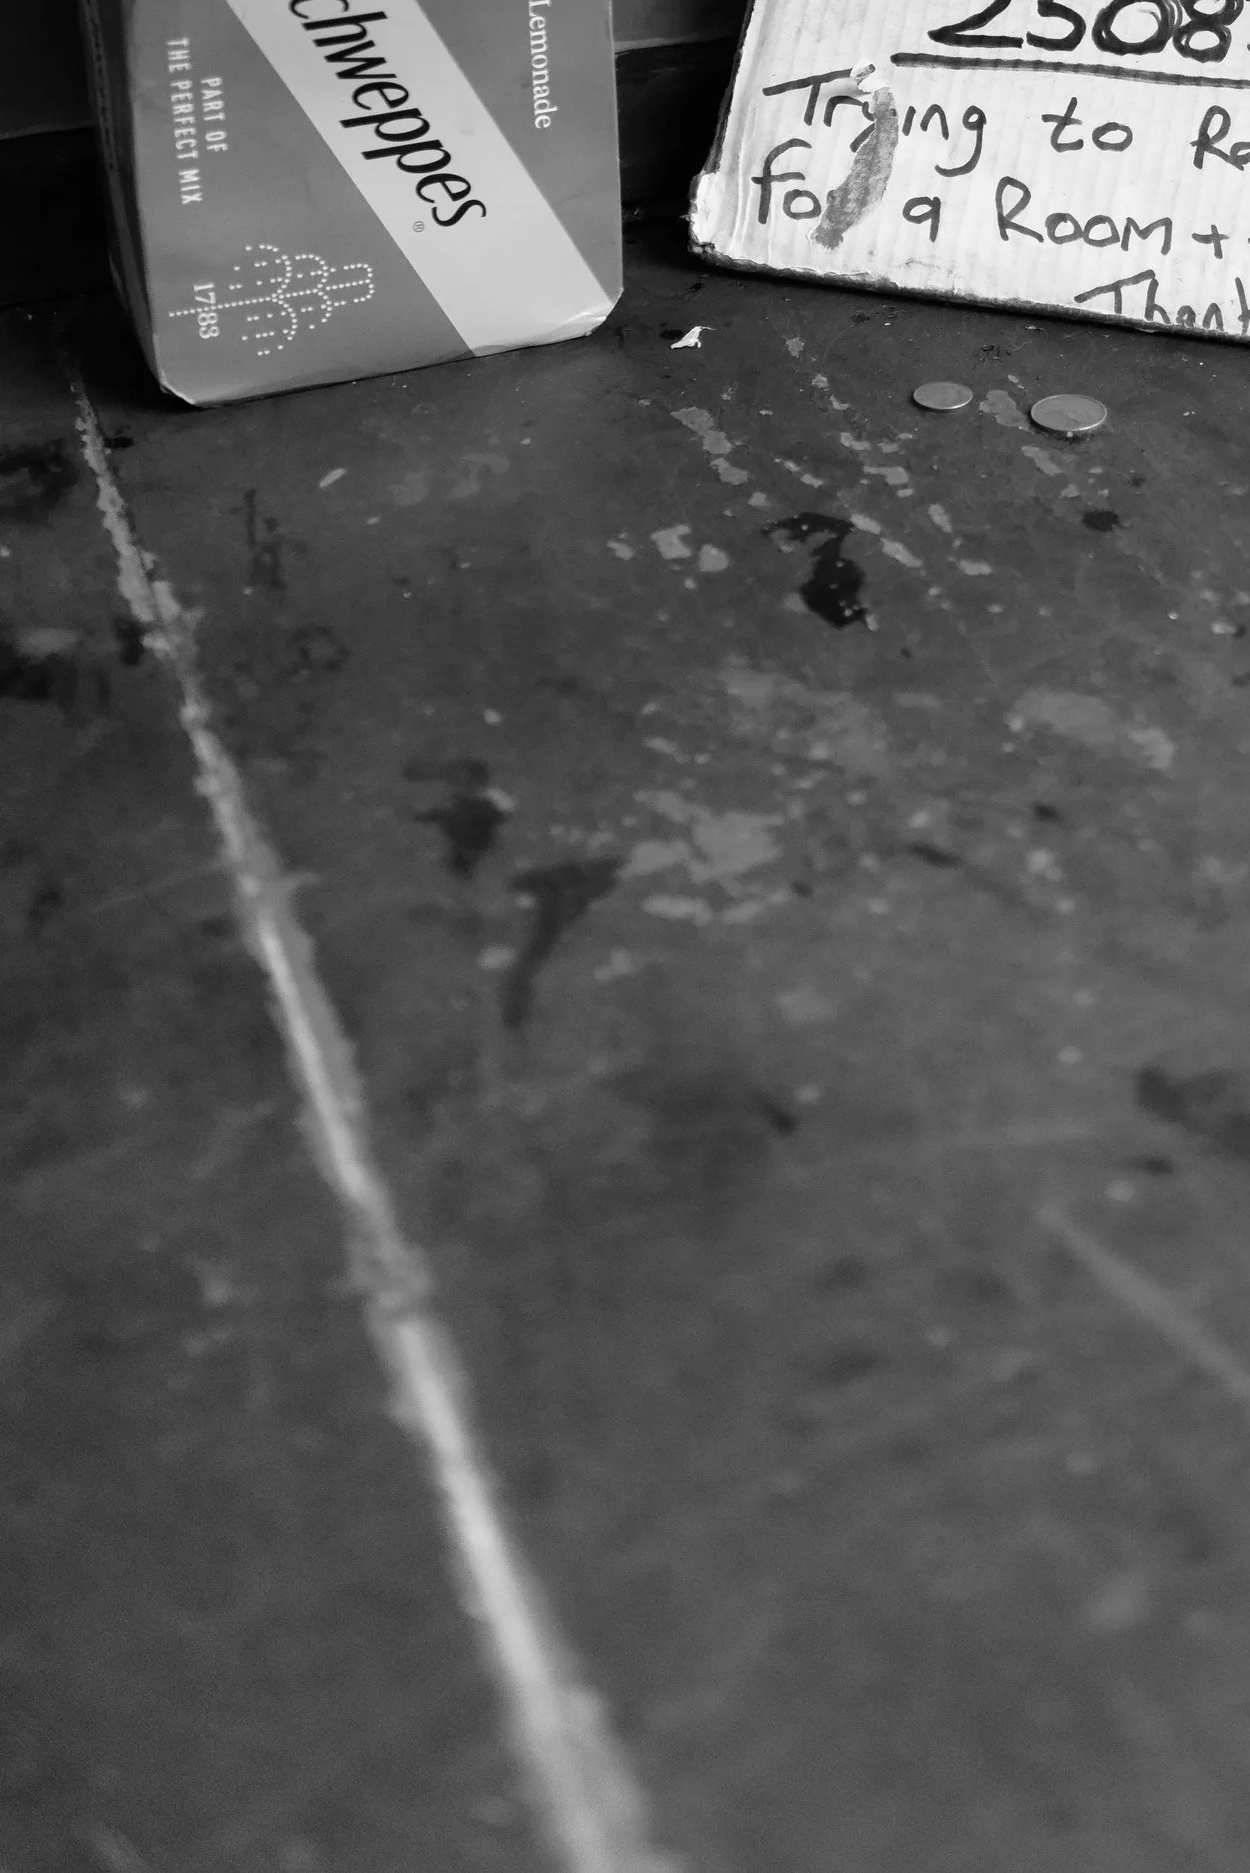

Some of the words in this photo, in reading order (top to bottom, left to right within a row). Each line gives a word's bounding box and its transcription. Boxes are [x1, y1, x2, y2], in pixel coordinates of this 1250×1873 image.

[167, 37, 191, 73] THE
[170, 80, 198, 159] PERFECT
[201, 77, 226, 121] PART
[205, 130, 228, 152] OF
[1042, 97, 1134, 152] to
[178, 169, 203, 205] MIX
[902, 196, 941, 242] a
